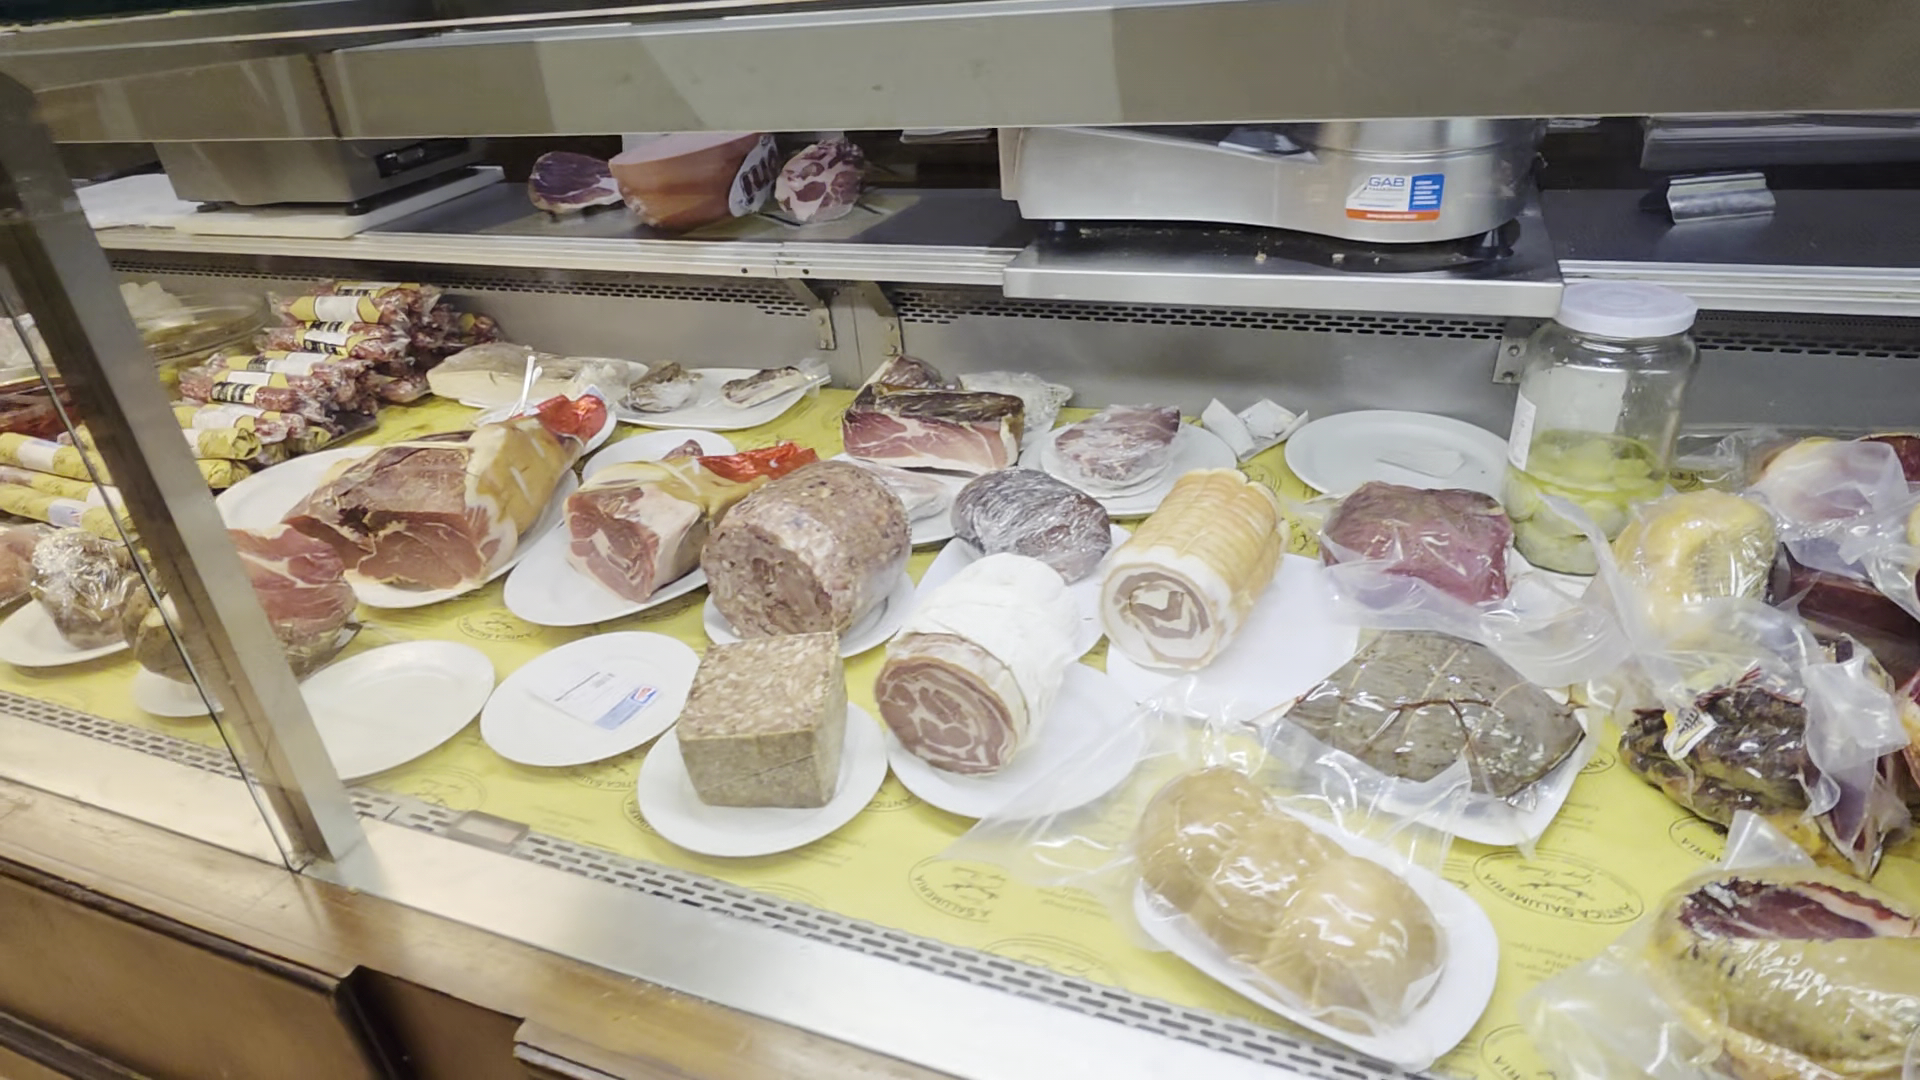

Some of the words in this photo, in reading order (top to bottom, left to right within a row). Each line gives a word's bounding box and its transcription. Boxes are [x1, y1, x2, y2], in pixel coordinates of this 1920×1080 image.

[1368, 176, 1405, 187] GAB
[912, 874, 976, 918] SALUMERIA
[1482, 872, 1575, 918] SALUMERIA
